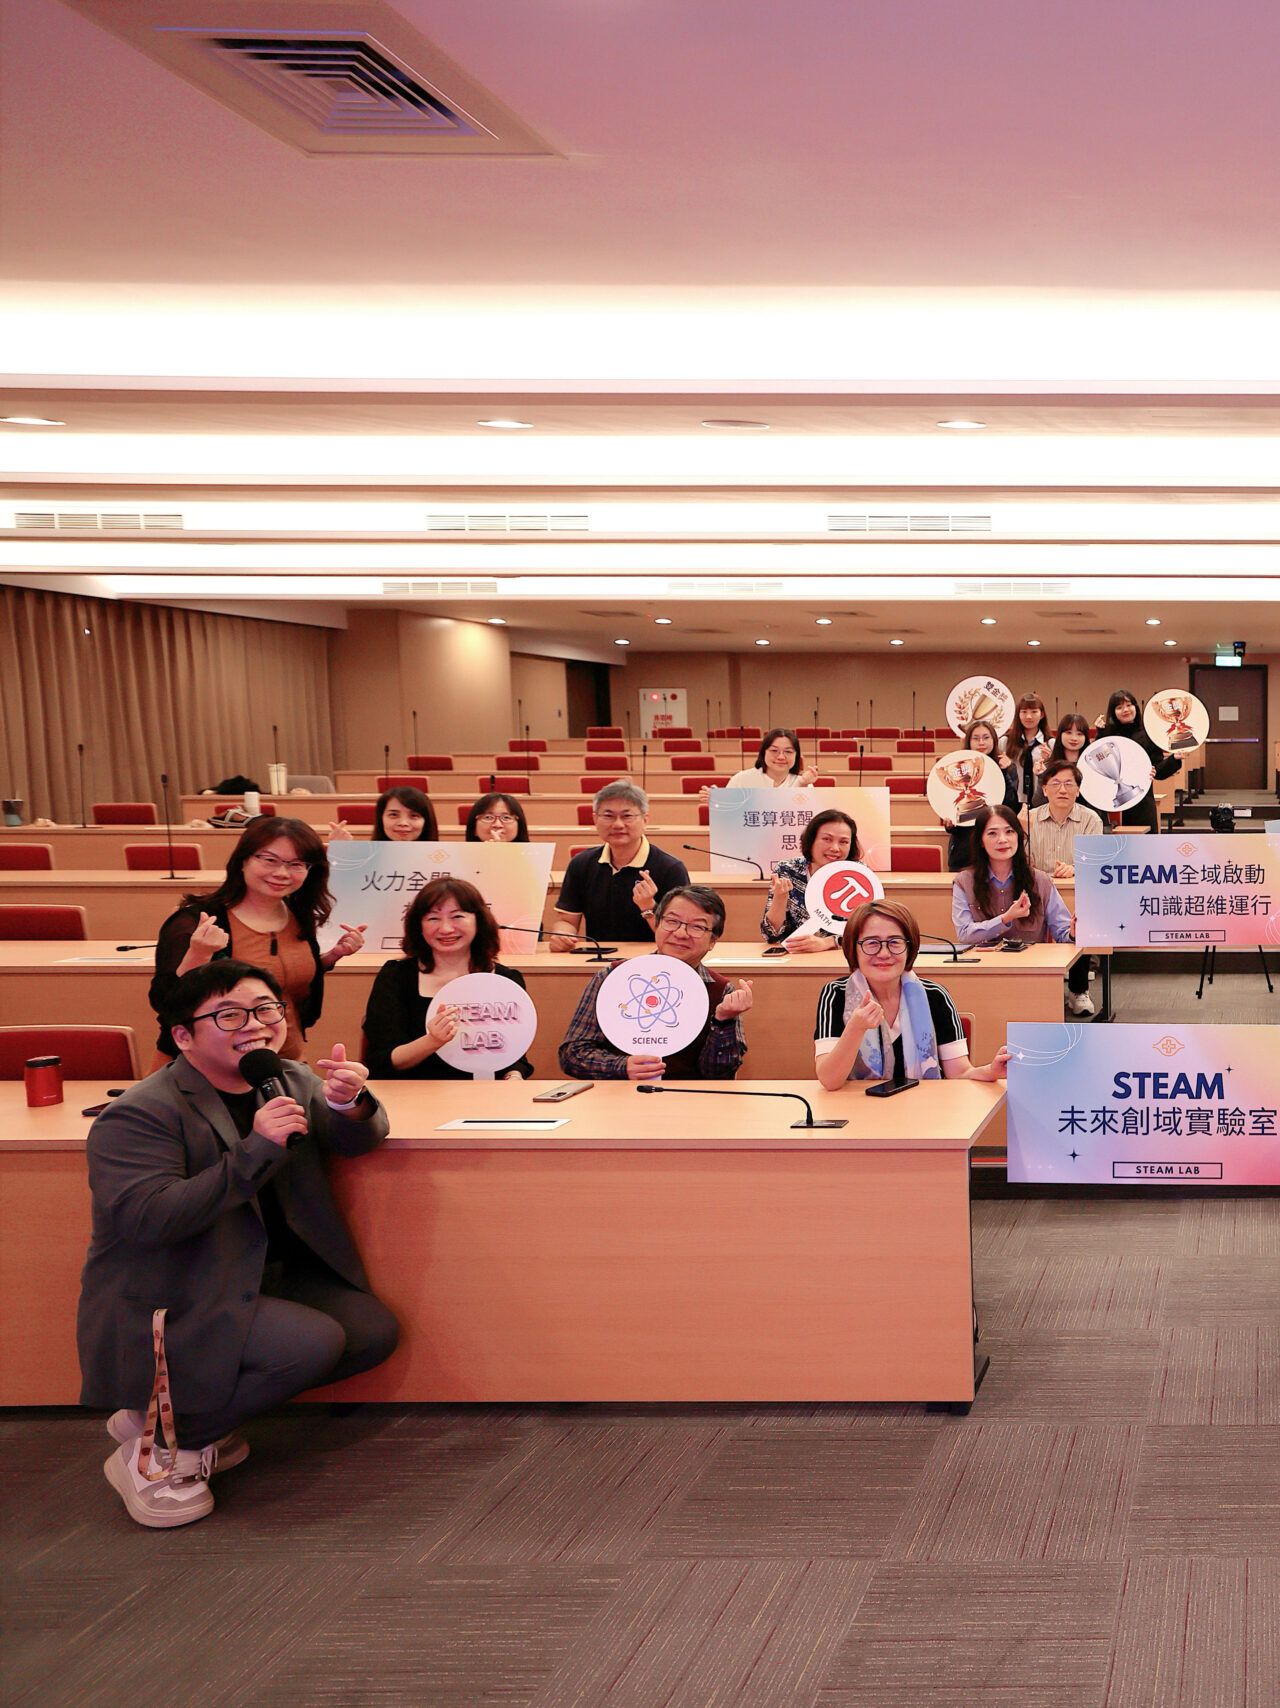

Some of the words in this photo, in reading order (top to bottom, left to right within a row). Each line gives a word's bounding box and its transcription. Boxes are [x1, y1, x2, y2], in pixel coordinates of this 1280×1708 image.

[1139, 895, 1272, 917] 知識超維運行
[814, 908, 833, 926] MATH
[1165, 932, 1192, 940] STEAM
[460, 1031, 504, 1051] LAB
[632, 1036, 668, 1045] SCIENCE
[1112, 1071, 1225, 1100] STEAM
[1058, 1105, 1278, 1137] 未來創域實驗室
[1135, 1165, 1174, 1175] STEAM
[1178, 1165, 1200, 1175] LAB
